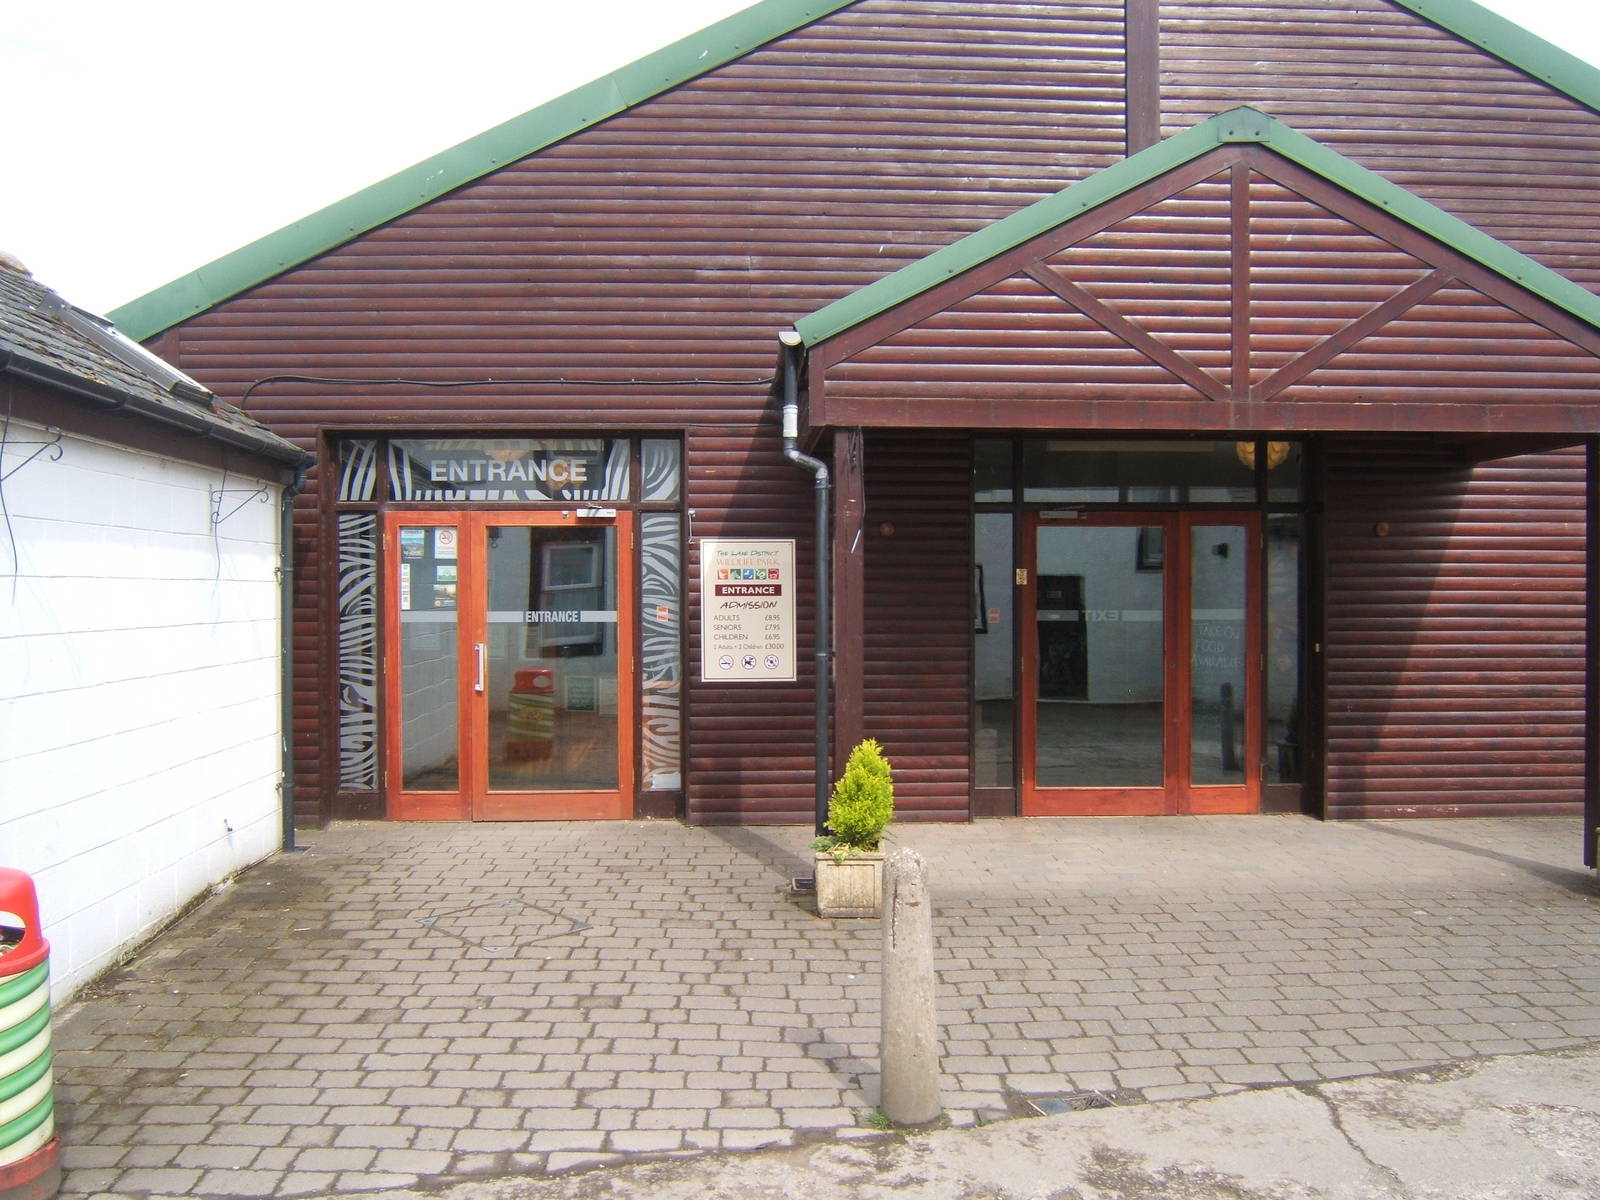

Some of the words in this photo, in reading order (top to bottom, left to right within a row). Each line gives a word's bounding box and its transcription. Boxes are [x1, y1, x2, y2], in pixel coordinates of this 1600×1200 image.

[430, 459, 588, 482] ENTRANCE
[721, 586, 775, 594] ENTRANCE
[720, 601, 778, 609] ADMISSION
[525, 610, 579, 623] ENTRANCE
[764, 633, 781, 641] £6.95
